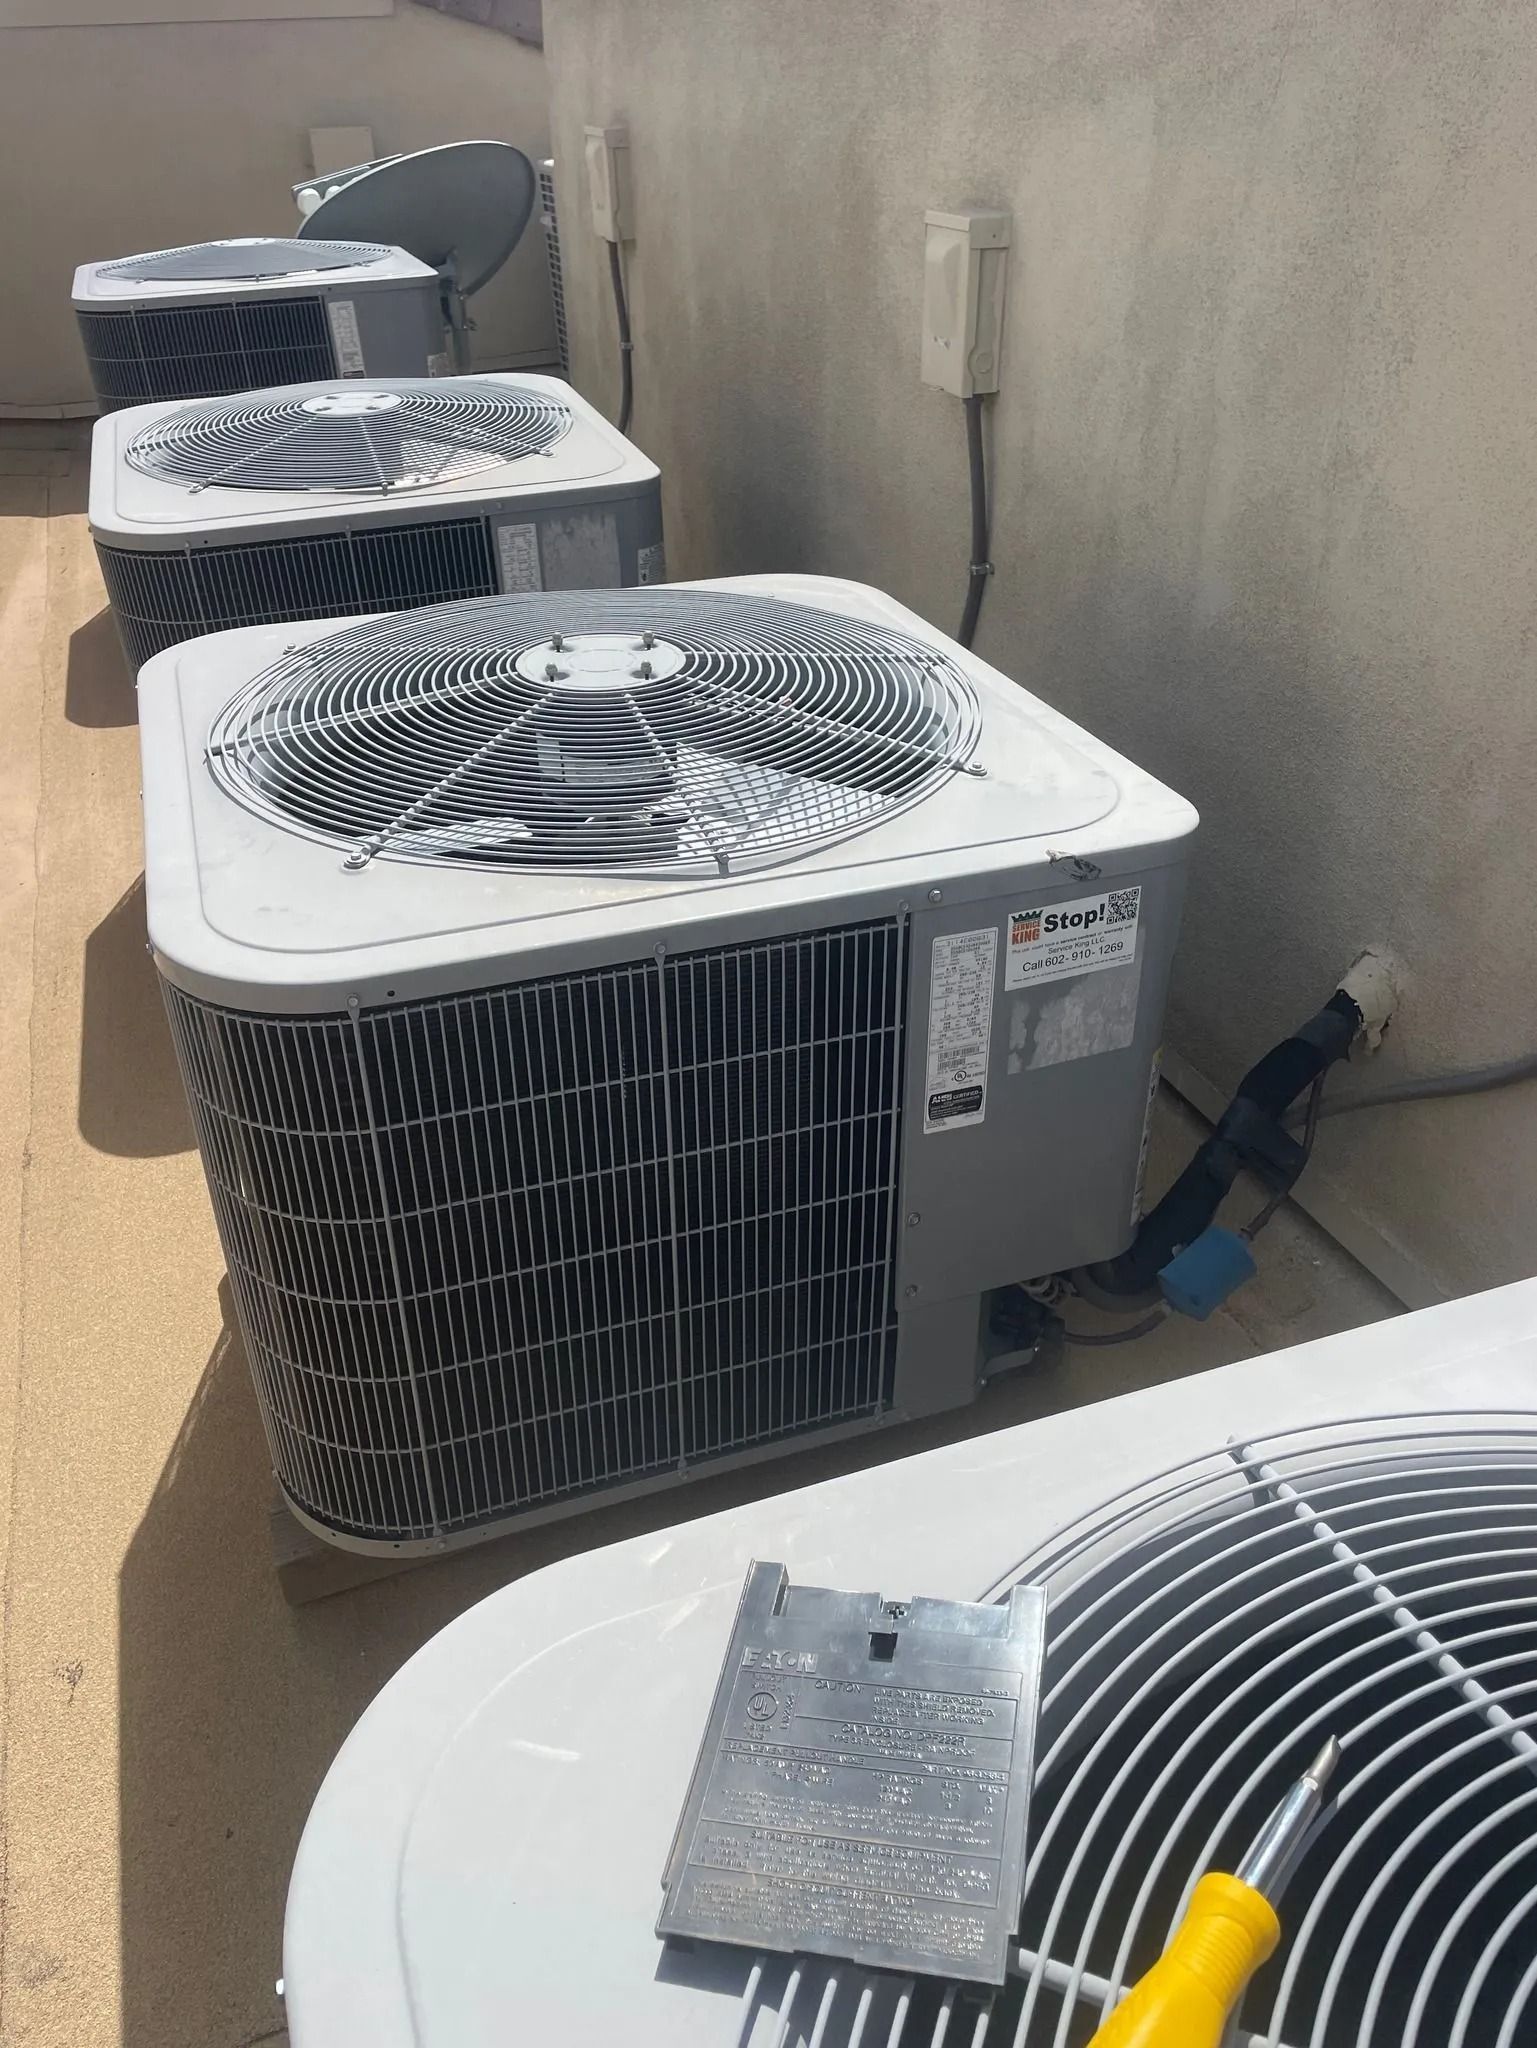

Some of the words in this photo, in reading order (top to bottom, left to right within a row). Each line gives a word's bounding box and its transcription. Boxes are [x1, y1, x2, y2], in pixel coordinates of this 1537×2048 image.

[1012, 919, 1040, 932] SERVICE
[1043, 903, 1105, 937] Stop!
[1011, 927, 1040, 945] KING
[1047, 943, 1072, 954] Service
[1074, 939, 1089, 949] King
[1091, 936, 1104, 944] LLC
[1022, 958, 1042, 972] Call
[743, 1647, 818, 1672] EATON
[753, 1698, 770, 1714] UL
[873, 1697, 892, 1705] WITH
[897, 1700, 915, 1708] THIS
[917, 1702, 946, 1711] SHIELD
[875, 1688, 891, 1696] LIVE
[896, 1690, 920, 1699] PARTS
[923, 1693, 941, 1701] ARE
[942, 1695, 982, 1706] EXPOSED
[872, 1706, 910, 1716] REPLACE
[941, 1713, 984, 1724] WORKING
[841, 1723, 891, 1737] CATALOG
[917, 1732, 965, 1746] DPF222R
[750, 1830, 793, 1843] SUITABLE
[837, 1842, 850, 1851] AS
